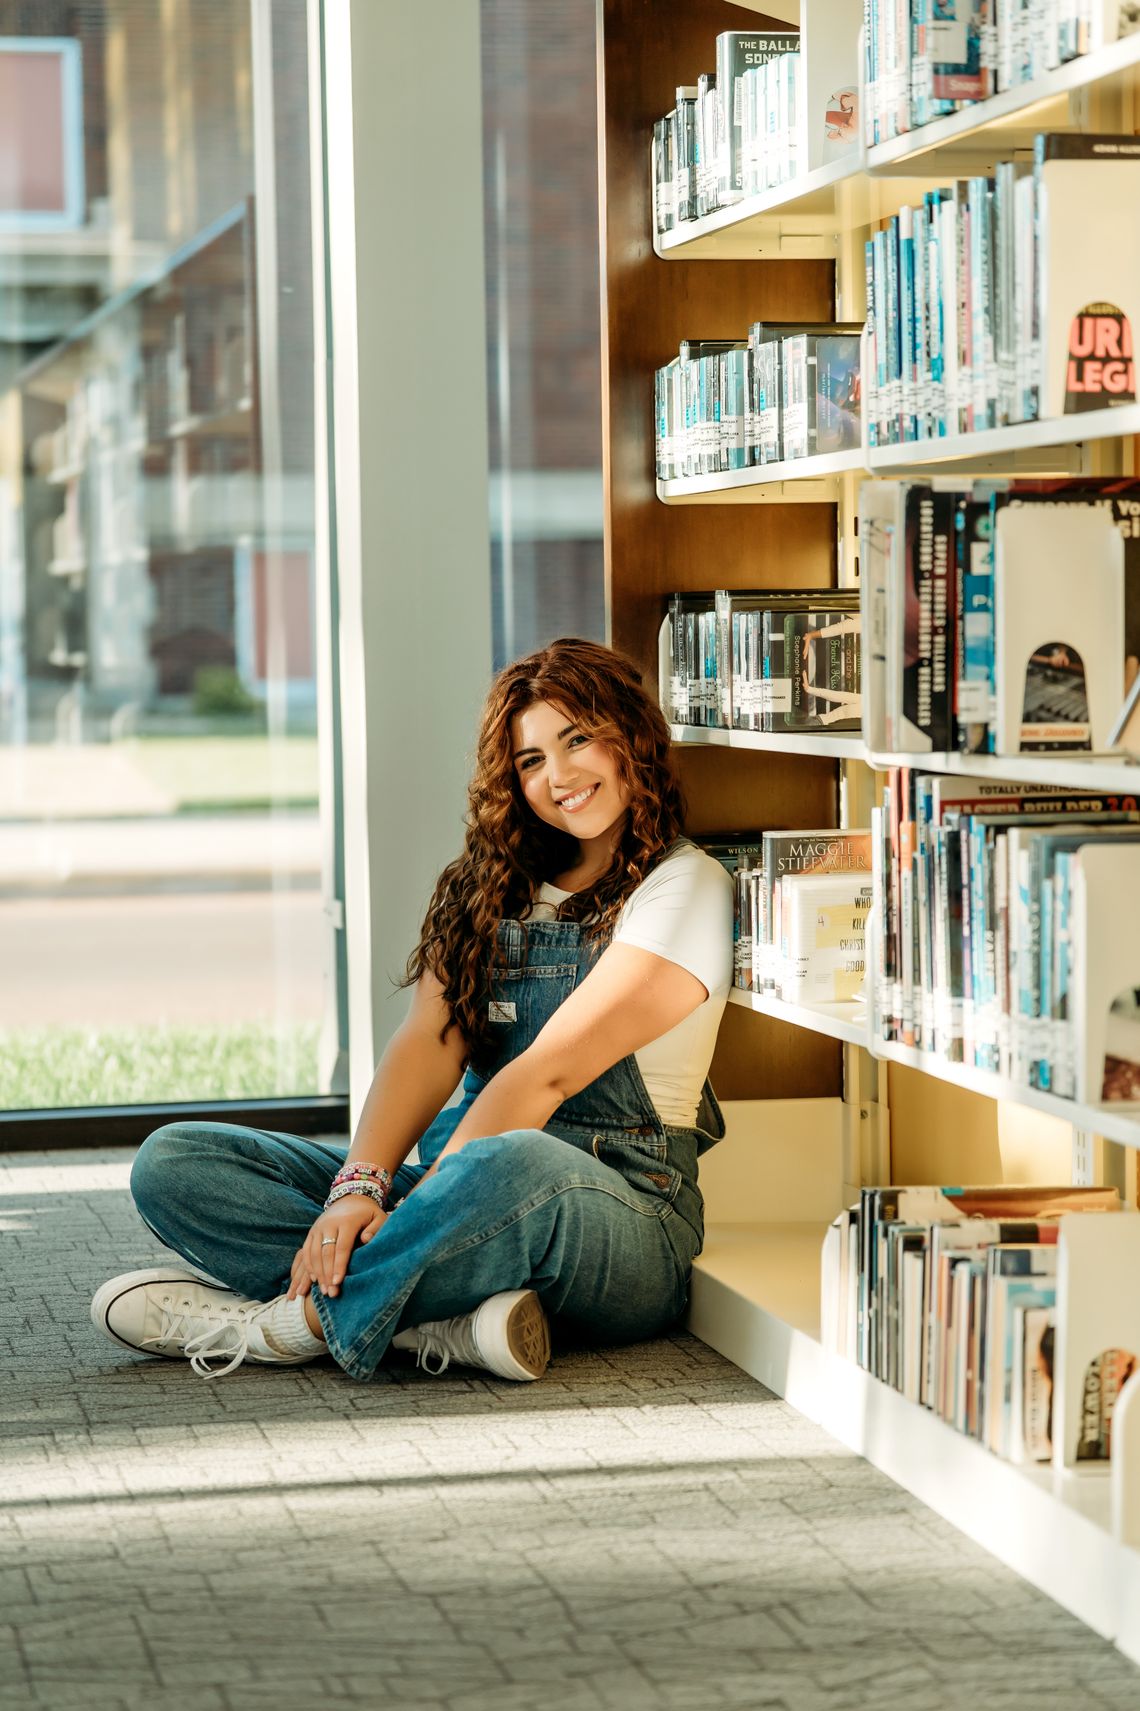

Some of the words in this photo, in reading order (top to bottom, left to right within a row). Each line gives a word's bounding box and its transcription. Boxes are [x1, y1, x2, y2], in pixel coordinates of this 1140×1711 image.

[738, 41, 757, 49] THE
[918, 500, 934, 571] LOCATIONS
[933, 534, 948, 576] SUPER
[932, 579, 947, 626] HEROES
[793, 635, 801, 675] Stephanie
[830, 640, 840, 667] French
[932, 635, 946, 692] VILLAINS
[830, 669, 841, 689] Kiss
[979, 785, 1022, 795] TOTALLY
[728, 847, 759, 855] WILSON
[789, 842, 854, 857] MAGGIE
[777, 855, 866, 871] STIEFVATER
[854, 897, 871, 909] WHO
